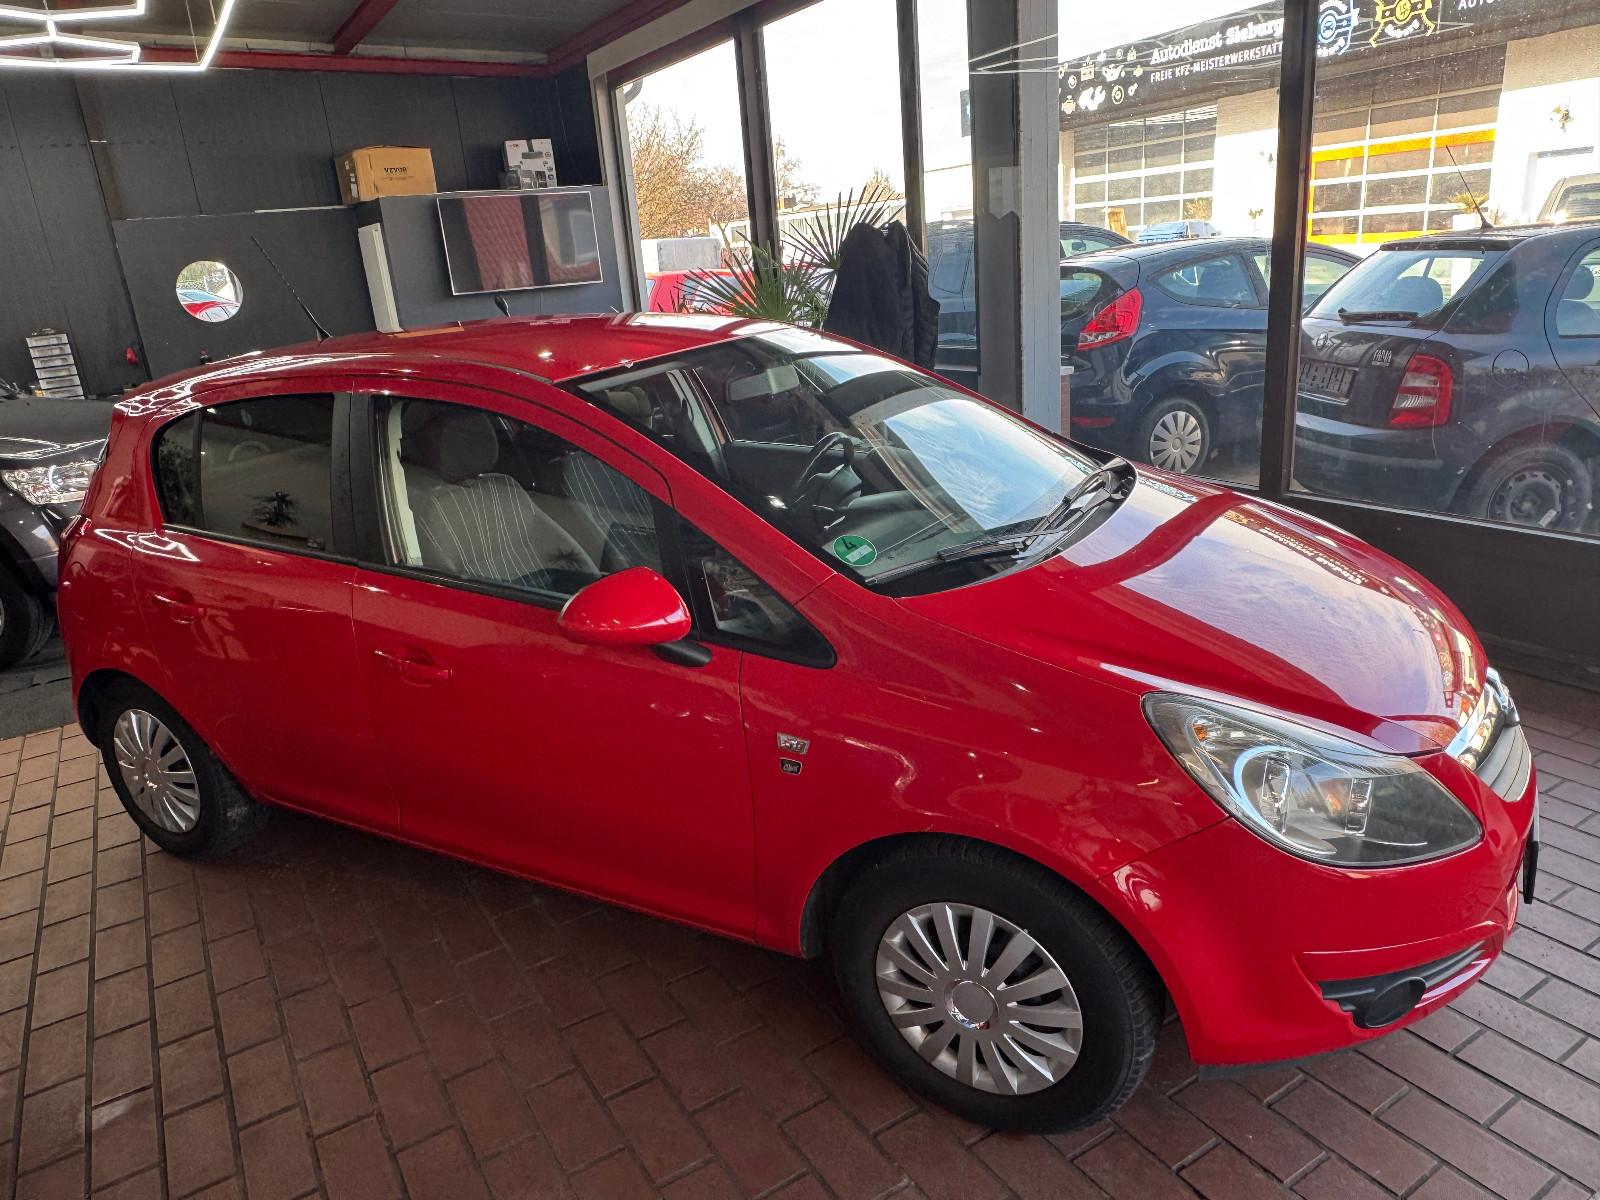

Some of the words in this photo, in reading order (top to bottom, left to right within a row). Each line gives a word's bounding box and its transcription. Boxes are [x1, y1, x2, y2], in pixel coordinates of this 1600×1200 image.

[1150, 32, 1223, 65] Autodienst
[1151, 69, 1173, 83] FREIE
[1175, 41, 1283, 77] KFZ-MEISTERWERKSTATT
